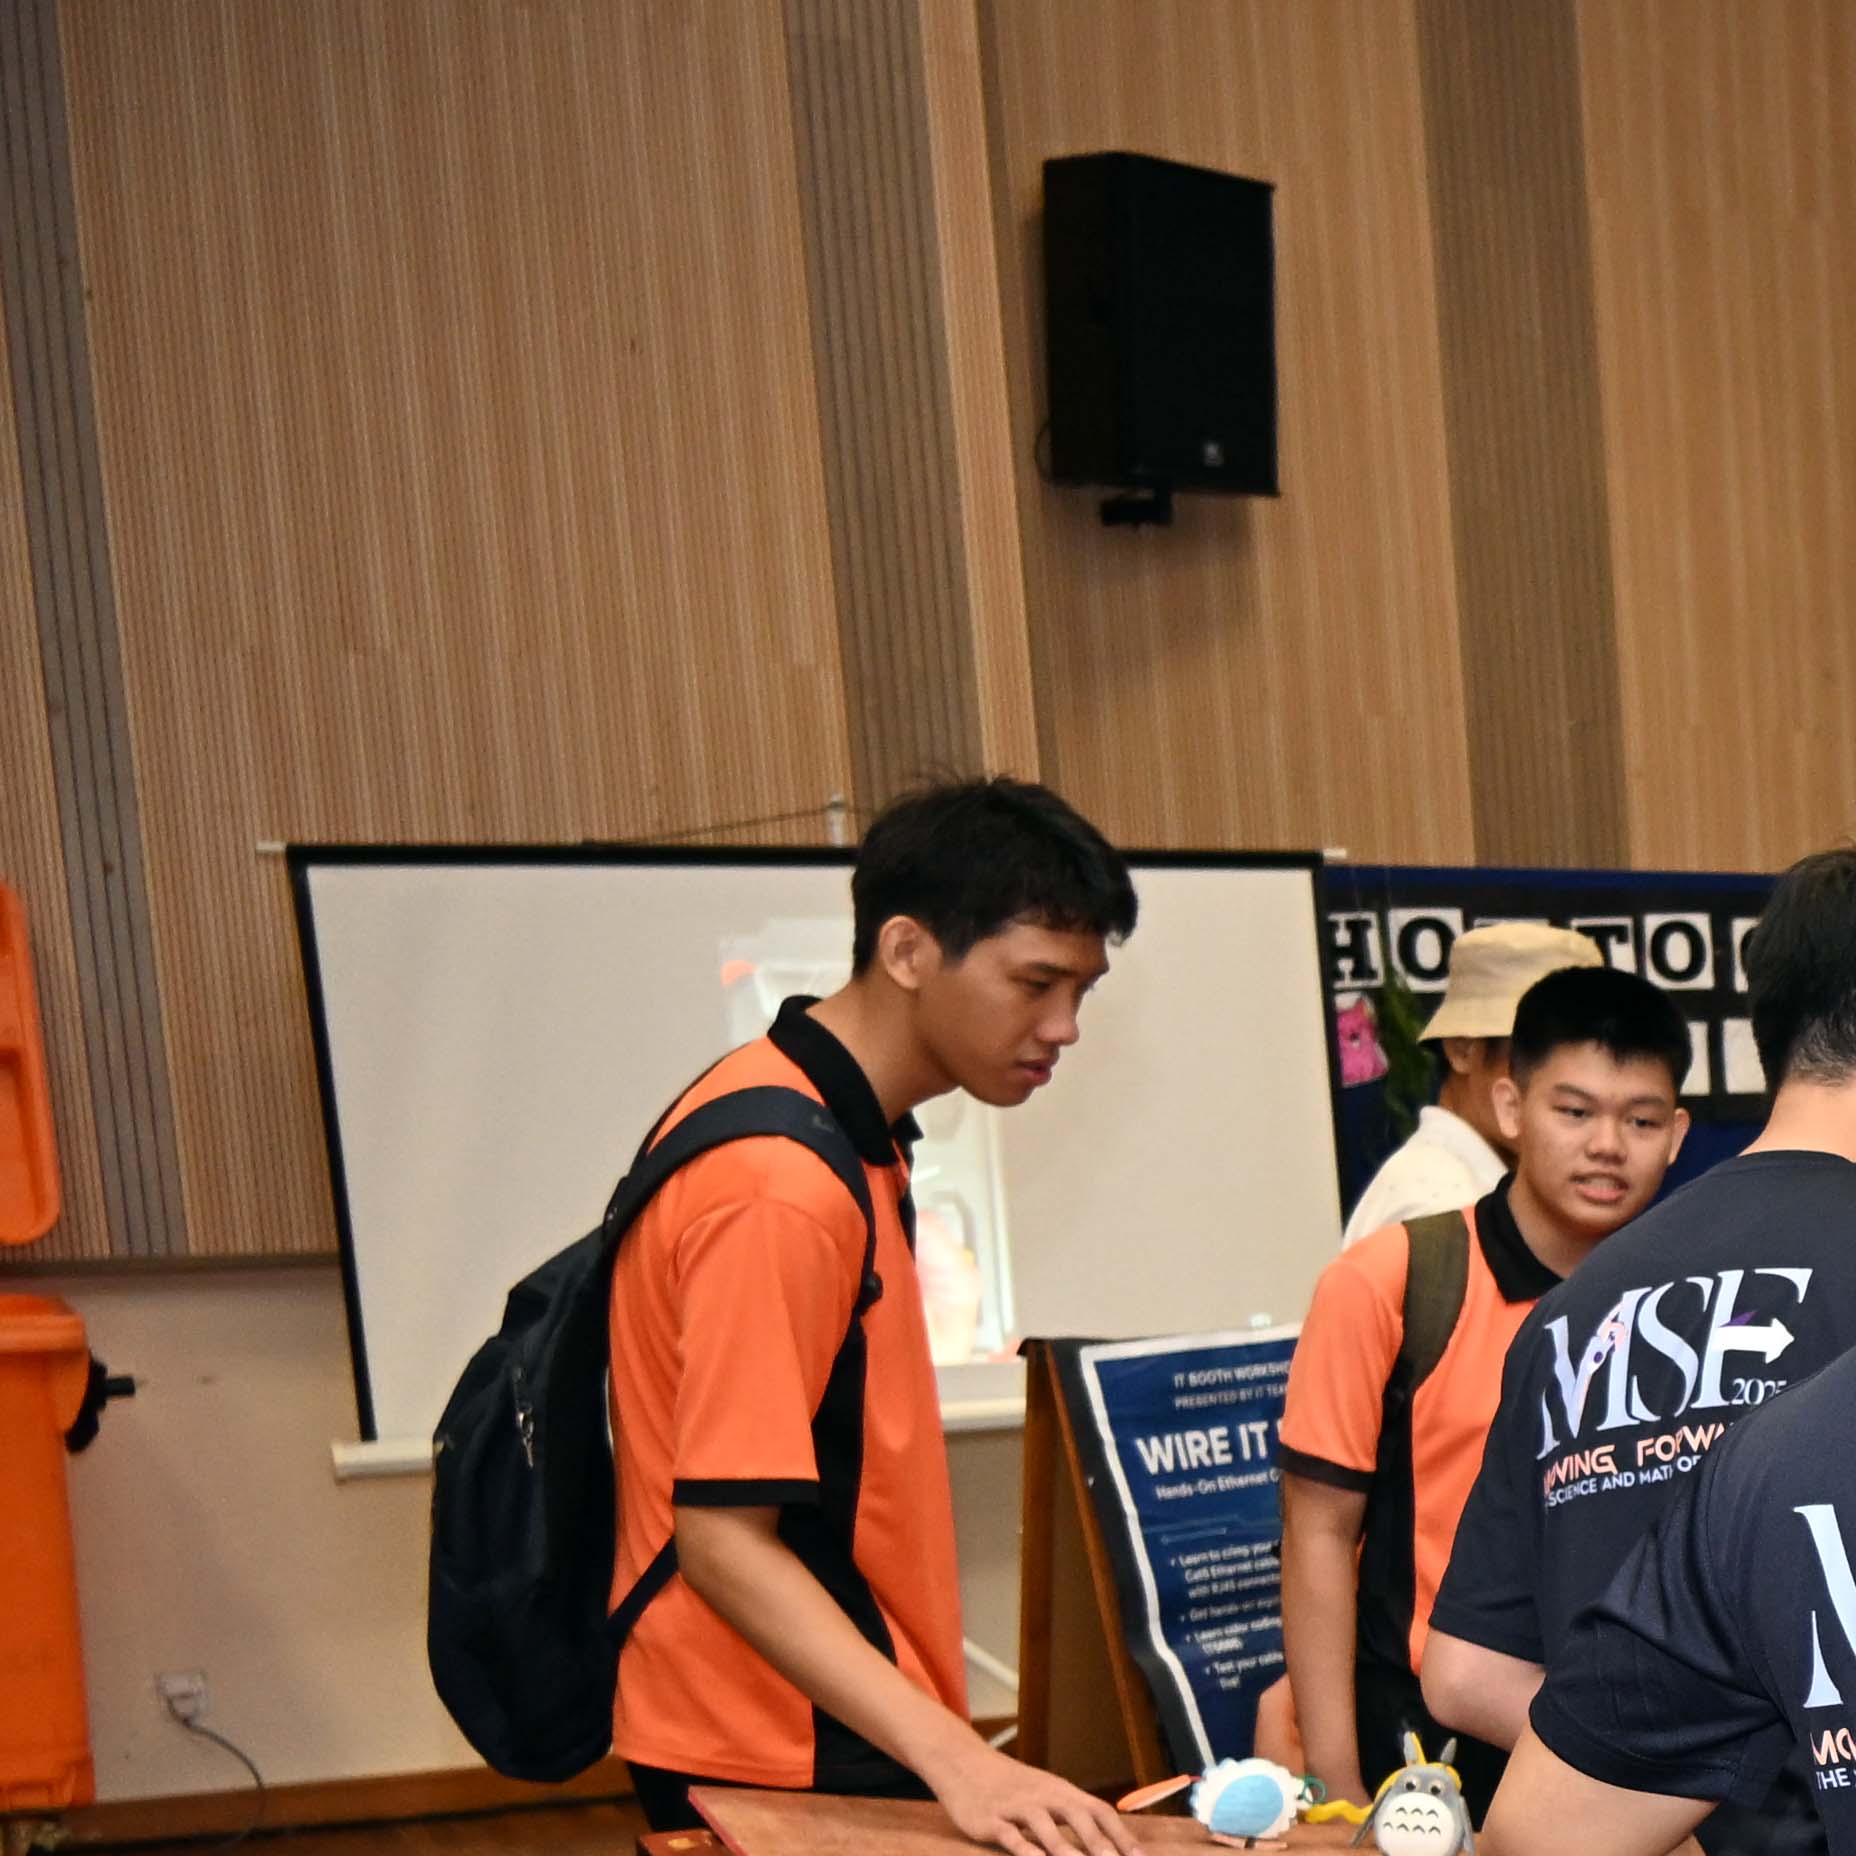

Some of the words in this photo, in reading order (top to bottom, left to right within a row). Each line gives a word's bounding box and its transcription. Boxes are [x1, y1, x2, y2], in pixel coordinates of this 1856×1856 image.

[1189, 1369, 1232, 1387] BOOTH
[1235, 1360, 1291, 1381] WORKSHO
[1267, 1384, 1287, 1398] TEA
[1135, 1426, 1233, 1475] WIRE
[1238, 1421, 1269, 1461] IT
[1602, 1471, 1635, 1491] AND
